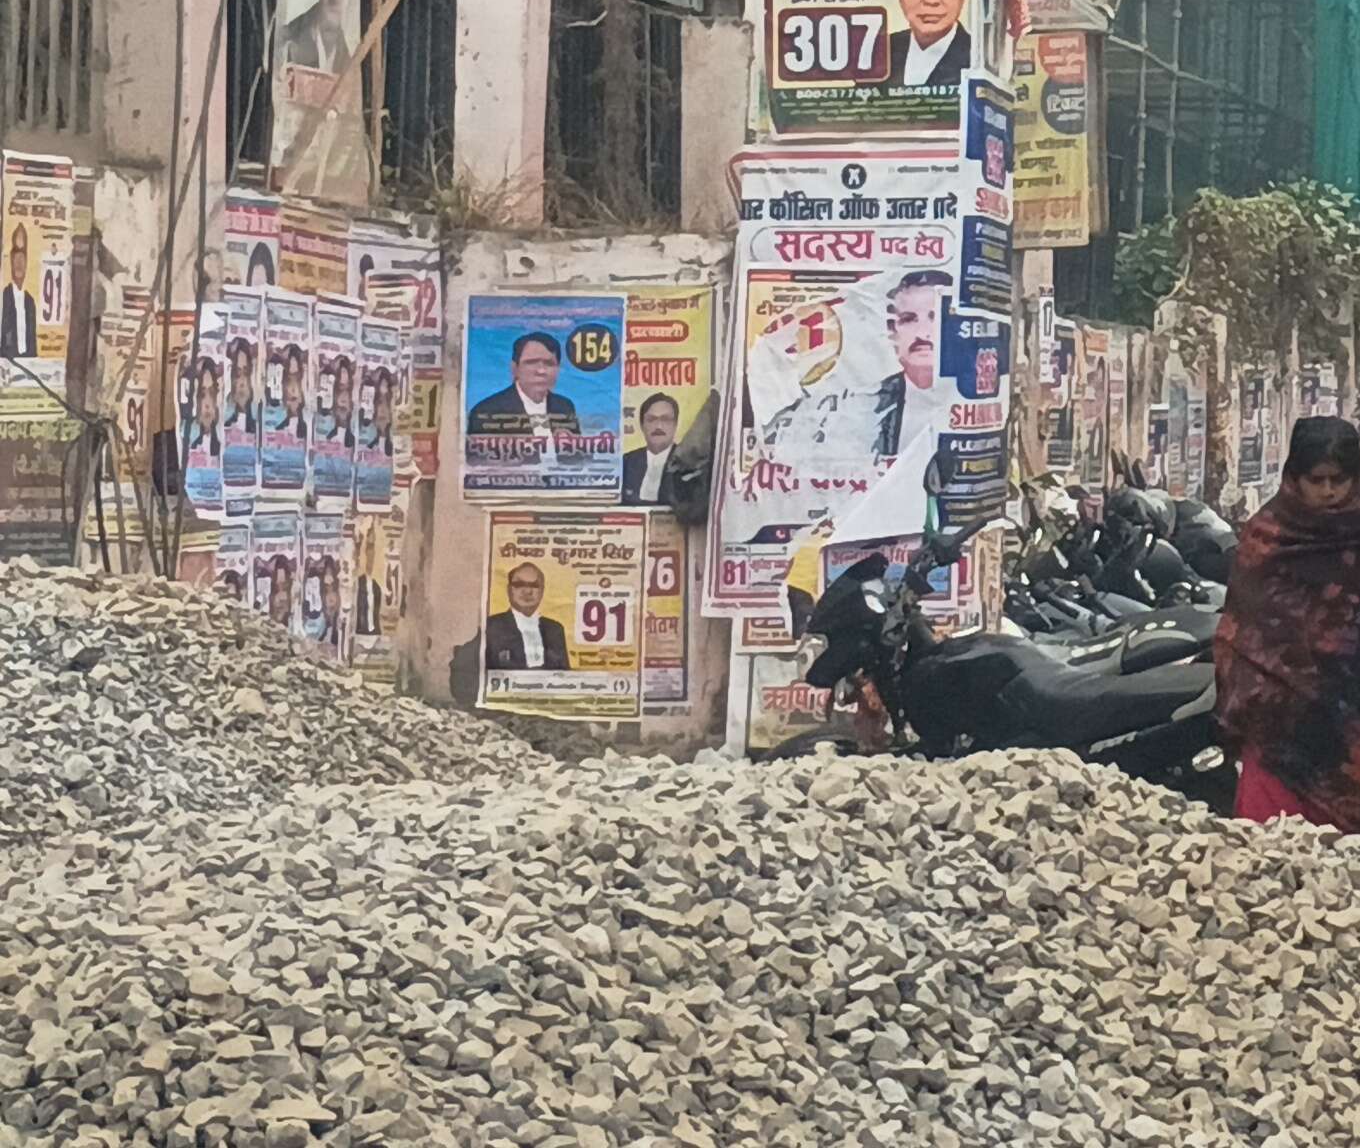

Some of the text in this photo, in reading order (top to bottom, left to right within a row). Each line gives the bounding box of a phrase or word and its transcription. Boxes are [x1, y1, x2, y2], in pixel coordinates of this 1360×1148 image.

[783, 13, 883, 73] 307
[774, 230, 876, 262] सदस्य
[42, 268, 63, 323] 91
[571, 331, 613, 365] 154
[722, 560, 748, 586] 81
[581, 599, 627, 643] 91
